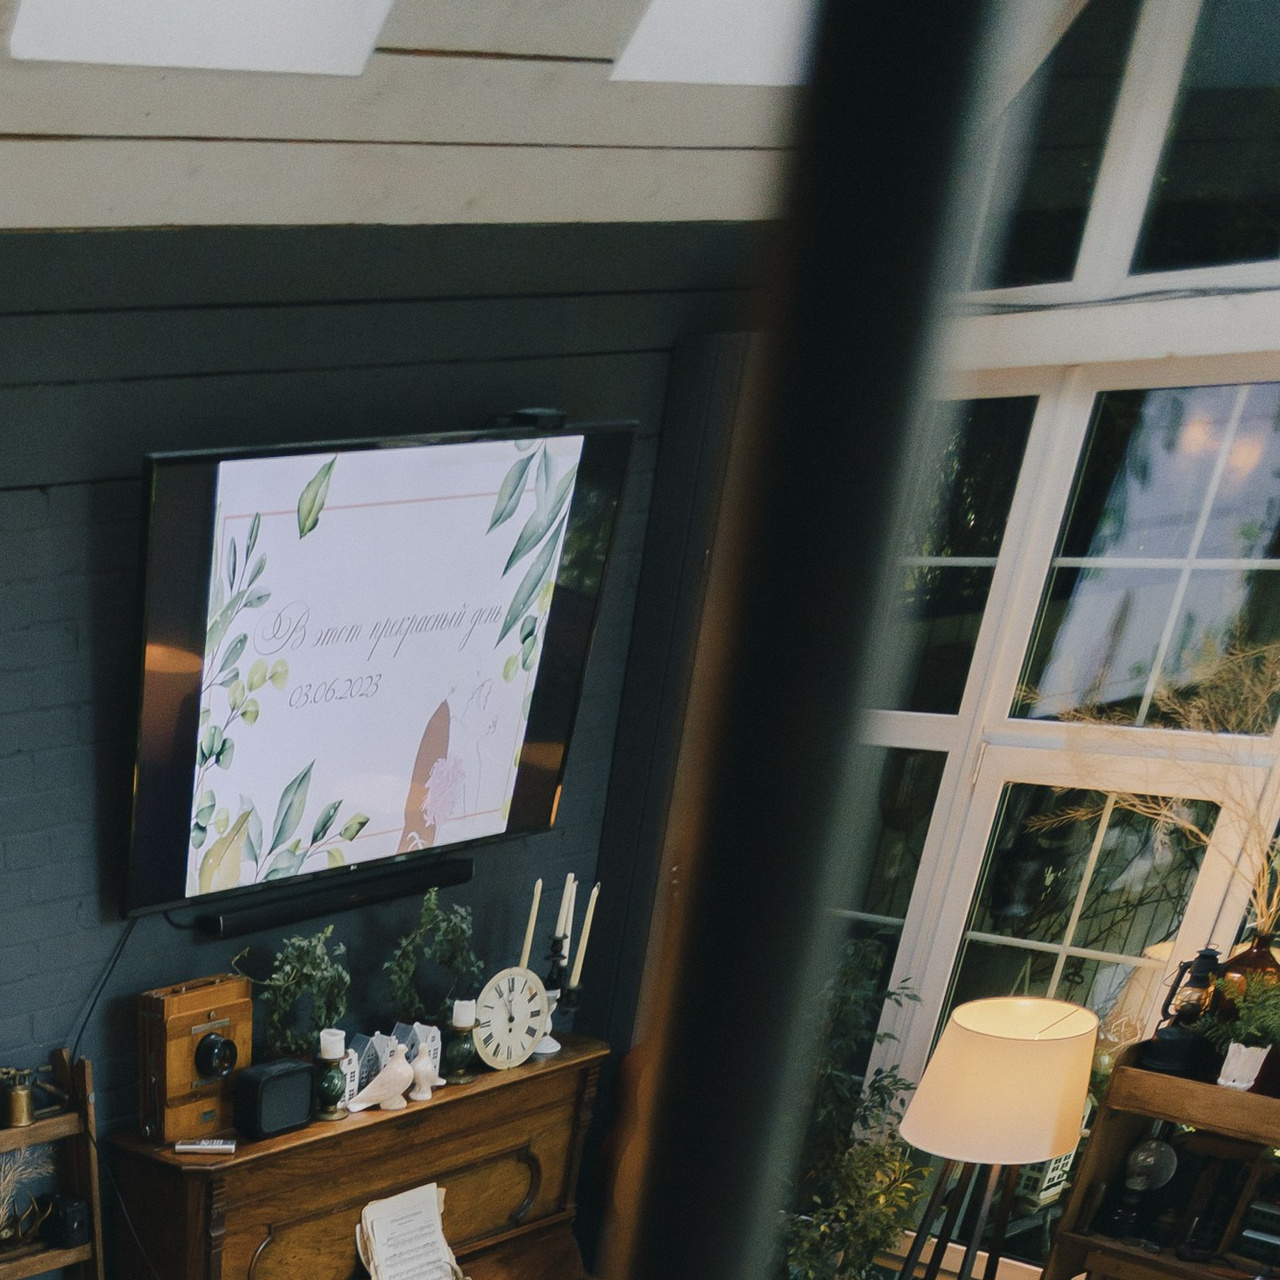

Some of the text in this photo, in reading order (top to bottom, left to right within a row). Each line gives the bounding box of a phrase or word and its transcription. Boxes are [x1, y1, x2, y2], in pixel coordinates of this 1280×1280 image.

[253, 601, 503, 662] В этот прекрасный день
[288, 673, 382, 709] 03.06.2023
